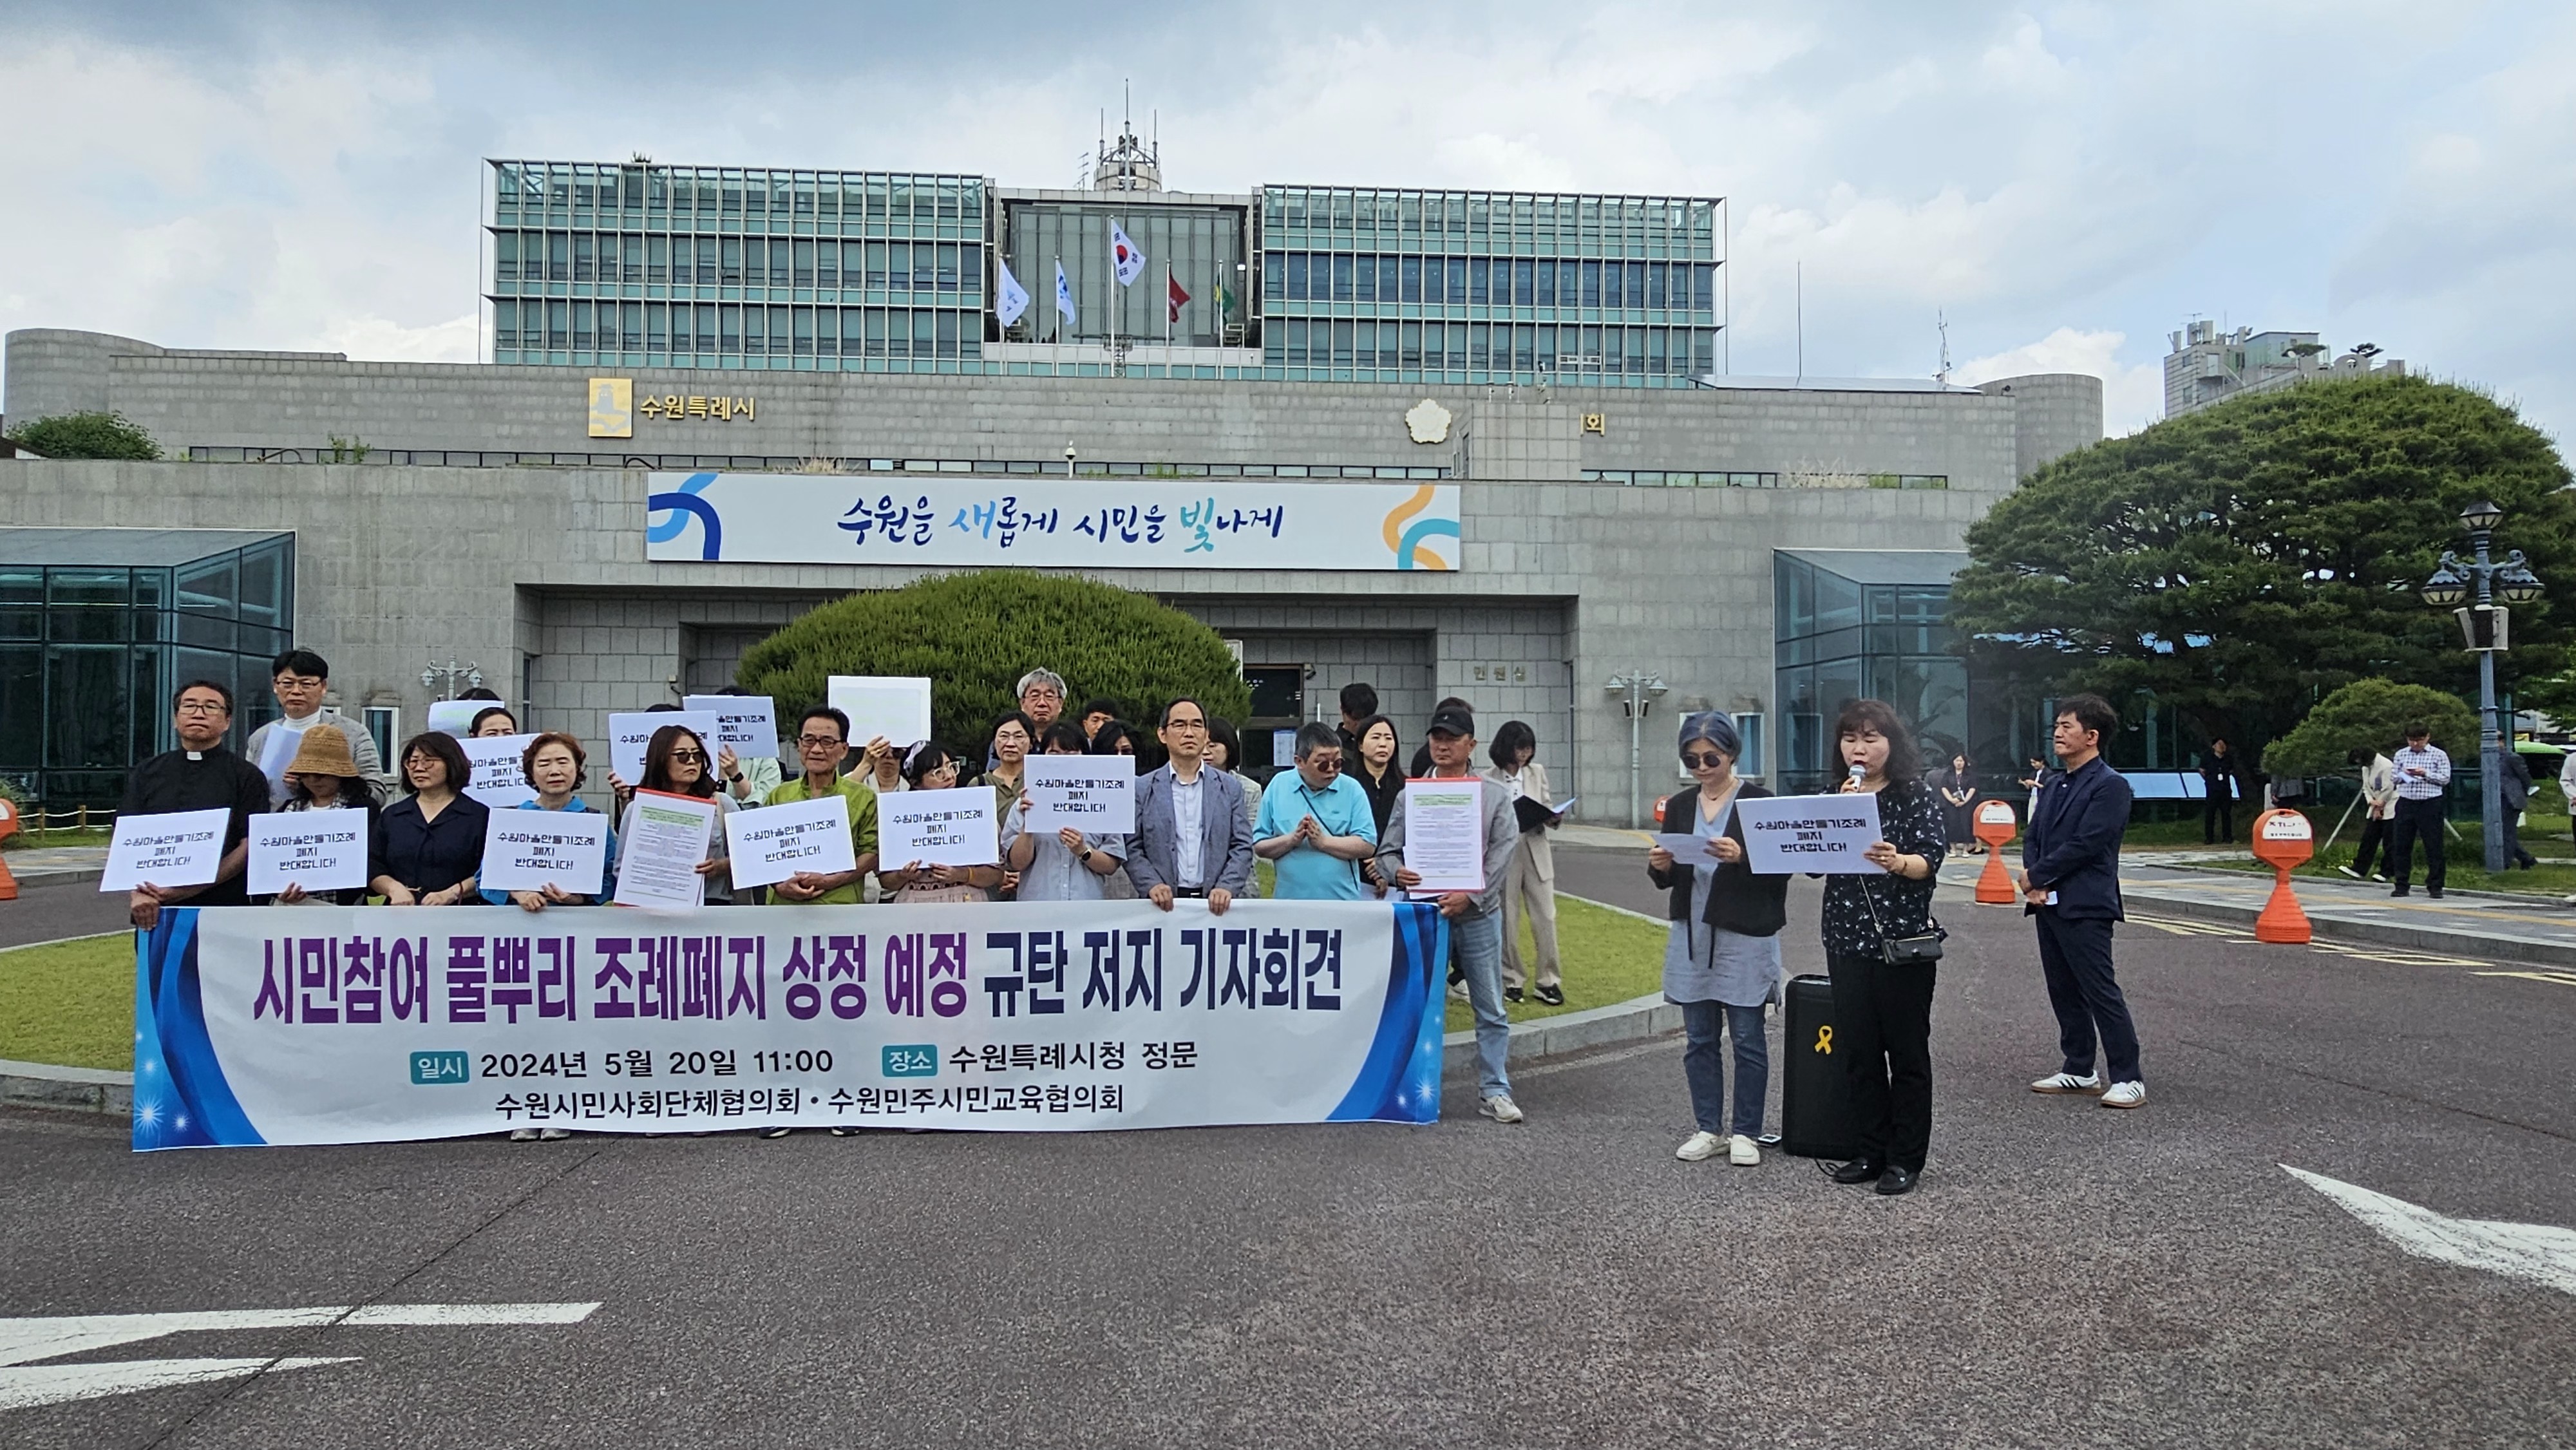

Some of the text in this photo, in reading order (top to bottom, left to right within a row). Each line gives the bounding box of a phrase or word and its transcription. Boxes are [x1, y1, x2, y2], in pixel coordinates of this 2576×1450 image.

[639, 395, 755, 422] 수원특례시
[837, 494, 1283, 554] 수원을 새롭게 시민을 빛나게
[716, 715, 766, 723] 을만들기조례
[492, 767, 512, 777] 폐지
[1036, 778, 1124, 789] 수원마을만들기조례
[1068, 791, 1088, 800] 폐지
[1053, 803, 1106, 813] 반대합니다!
[893, 809, 983, 824] 수원마을만들기조례
[927, 824, 947, 834] 폐지
[1754, 818, 1866, 830] 수원마을만들기조례
[743, 819, 837, 842] 수원마을만들기조례
[1796, 831, 1823, 840] 폐지
[122, 831, 214, 847] 수원마을만들기조례
[260, 832, 355, 847] 수원마을만들기조례
[497, 832, 595, 846] 수원마을만들기조례
[779, 836, 800, 849] 폐지
[912, 834, 965, 847] 반대합니다!
[155, 847, 175, 856] 폐지
[296, 847, 317, 857] 폐지
[533, 847, 555, 856] 폐지
[765, 845, 821, 862] 반대합니다!
[1780, 842, 1847, 853] 반대합니다!
[136, 857, 191, 869] 반대합니다!
[279, 858, 337, 871] 반대합니다!
[515, 858, 574, 870] 반대합니다!
[254, 928, 1342, 1024] 시민참여 풀뿌리 조례폐지 상정 예정 규탄 저지 기자회견
[417, 1041, 1198, 1079] 일시 2024년 5월 20일 11:00 장소 수원특례시청 정문
[495, 1087, 800, 1120] 수원시민사회단체협의회
[828, 1085, 1123, 1115] 수원민주시민교육협의회
